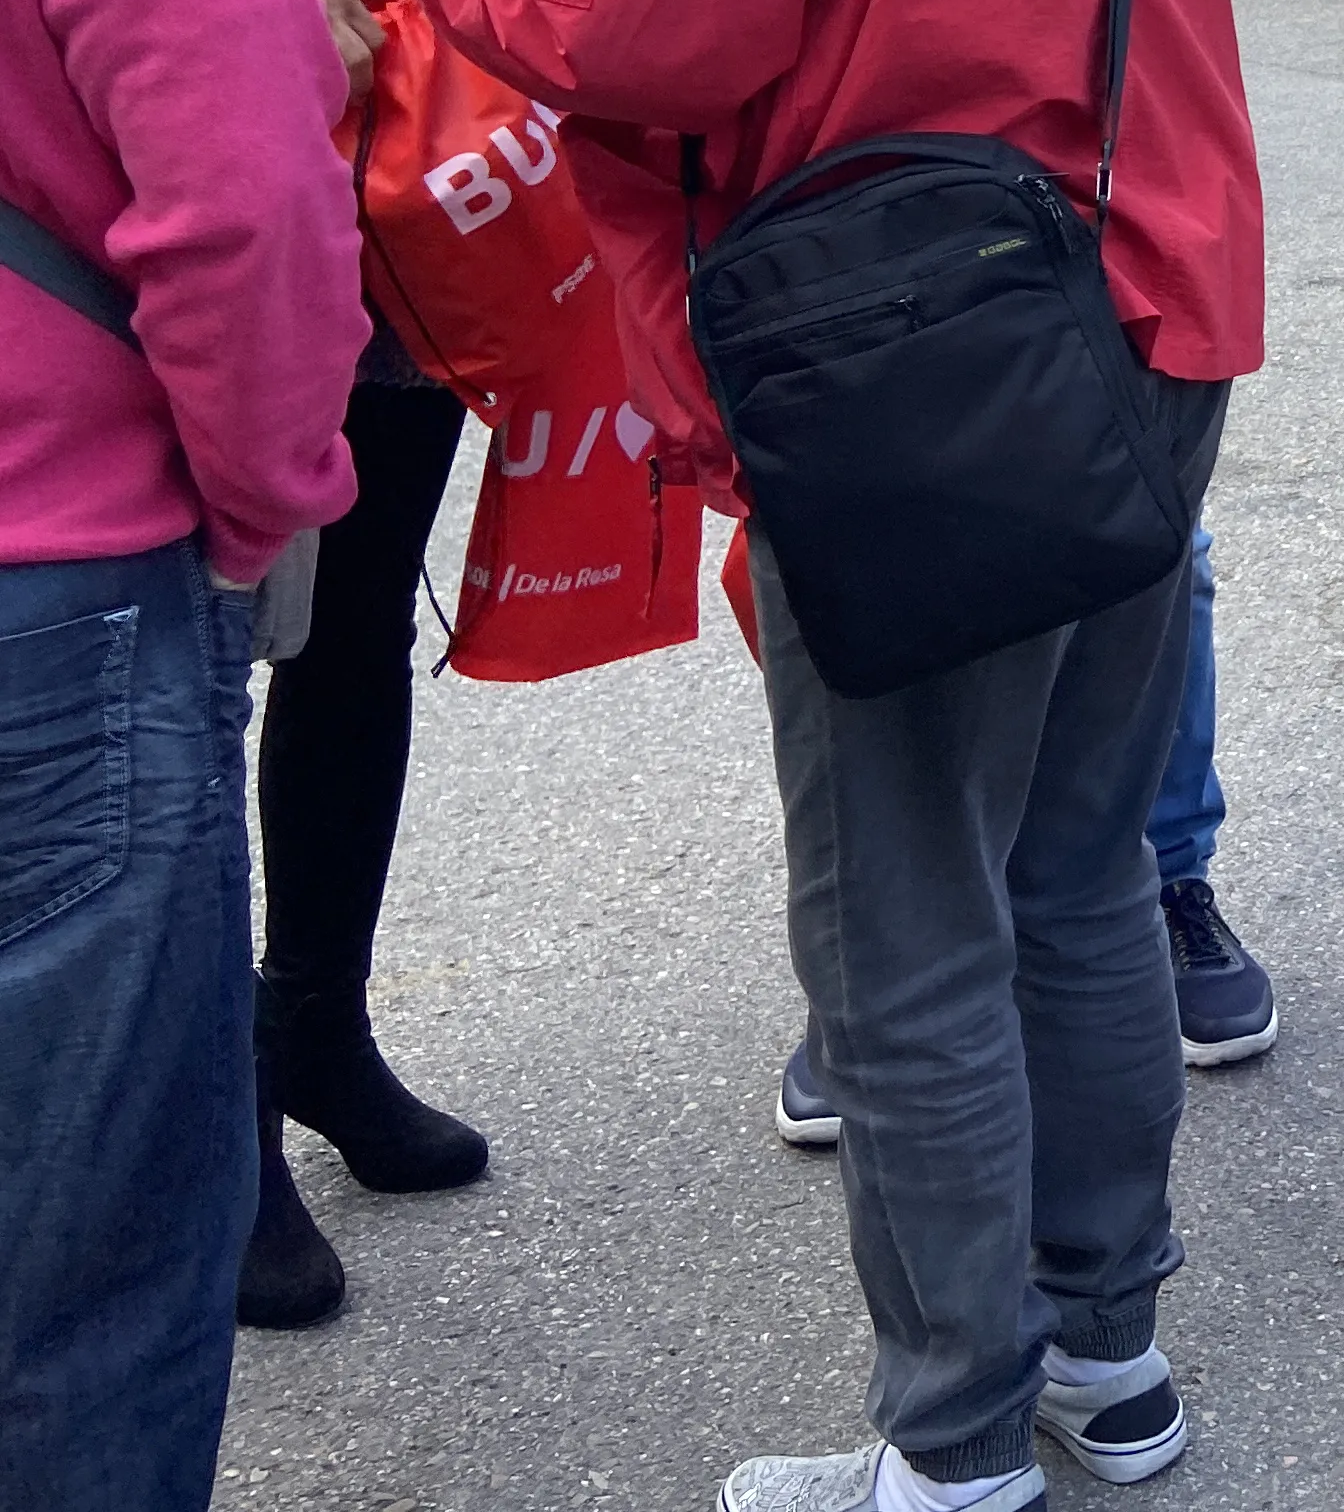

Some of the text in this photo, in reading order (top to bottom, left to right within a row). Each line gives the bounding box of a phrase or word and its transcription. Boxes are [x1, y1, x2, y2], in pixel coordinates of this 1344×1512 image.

[514, 572, 550, 595] De
[551, 571, 573, 593] la
[574, 562, 622, 590] Rosa
